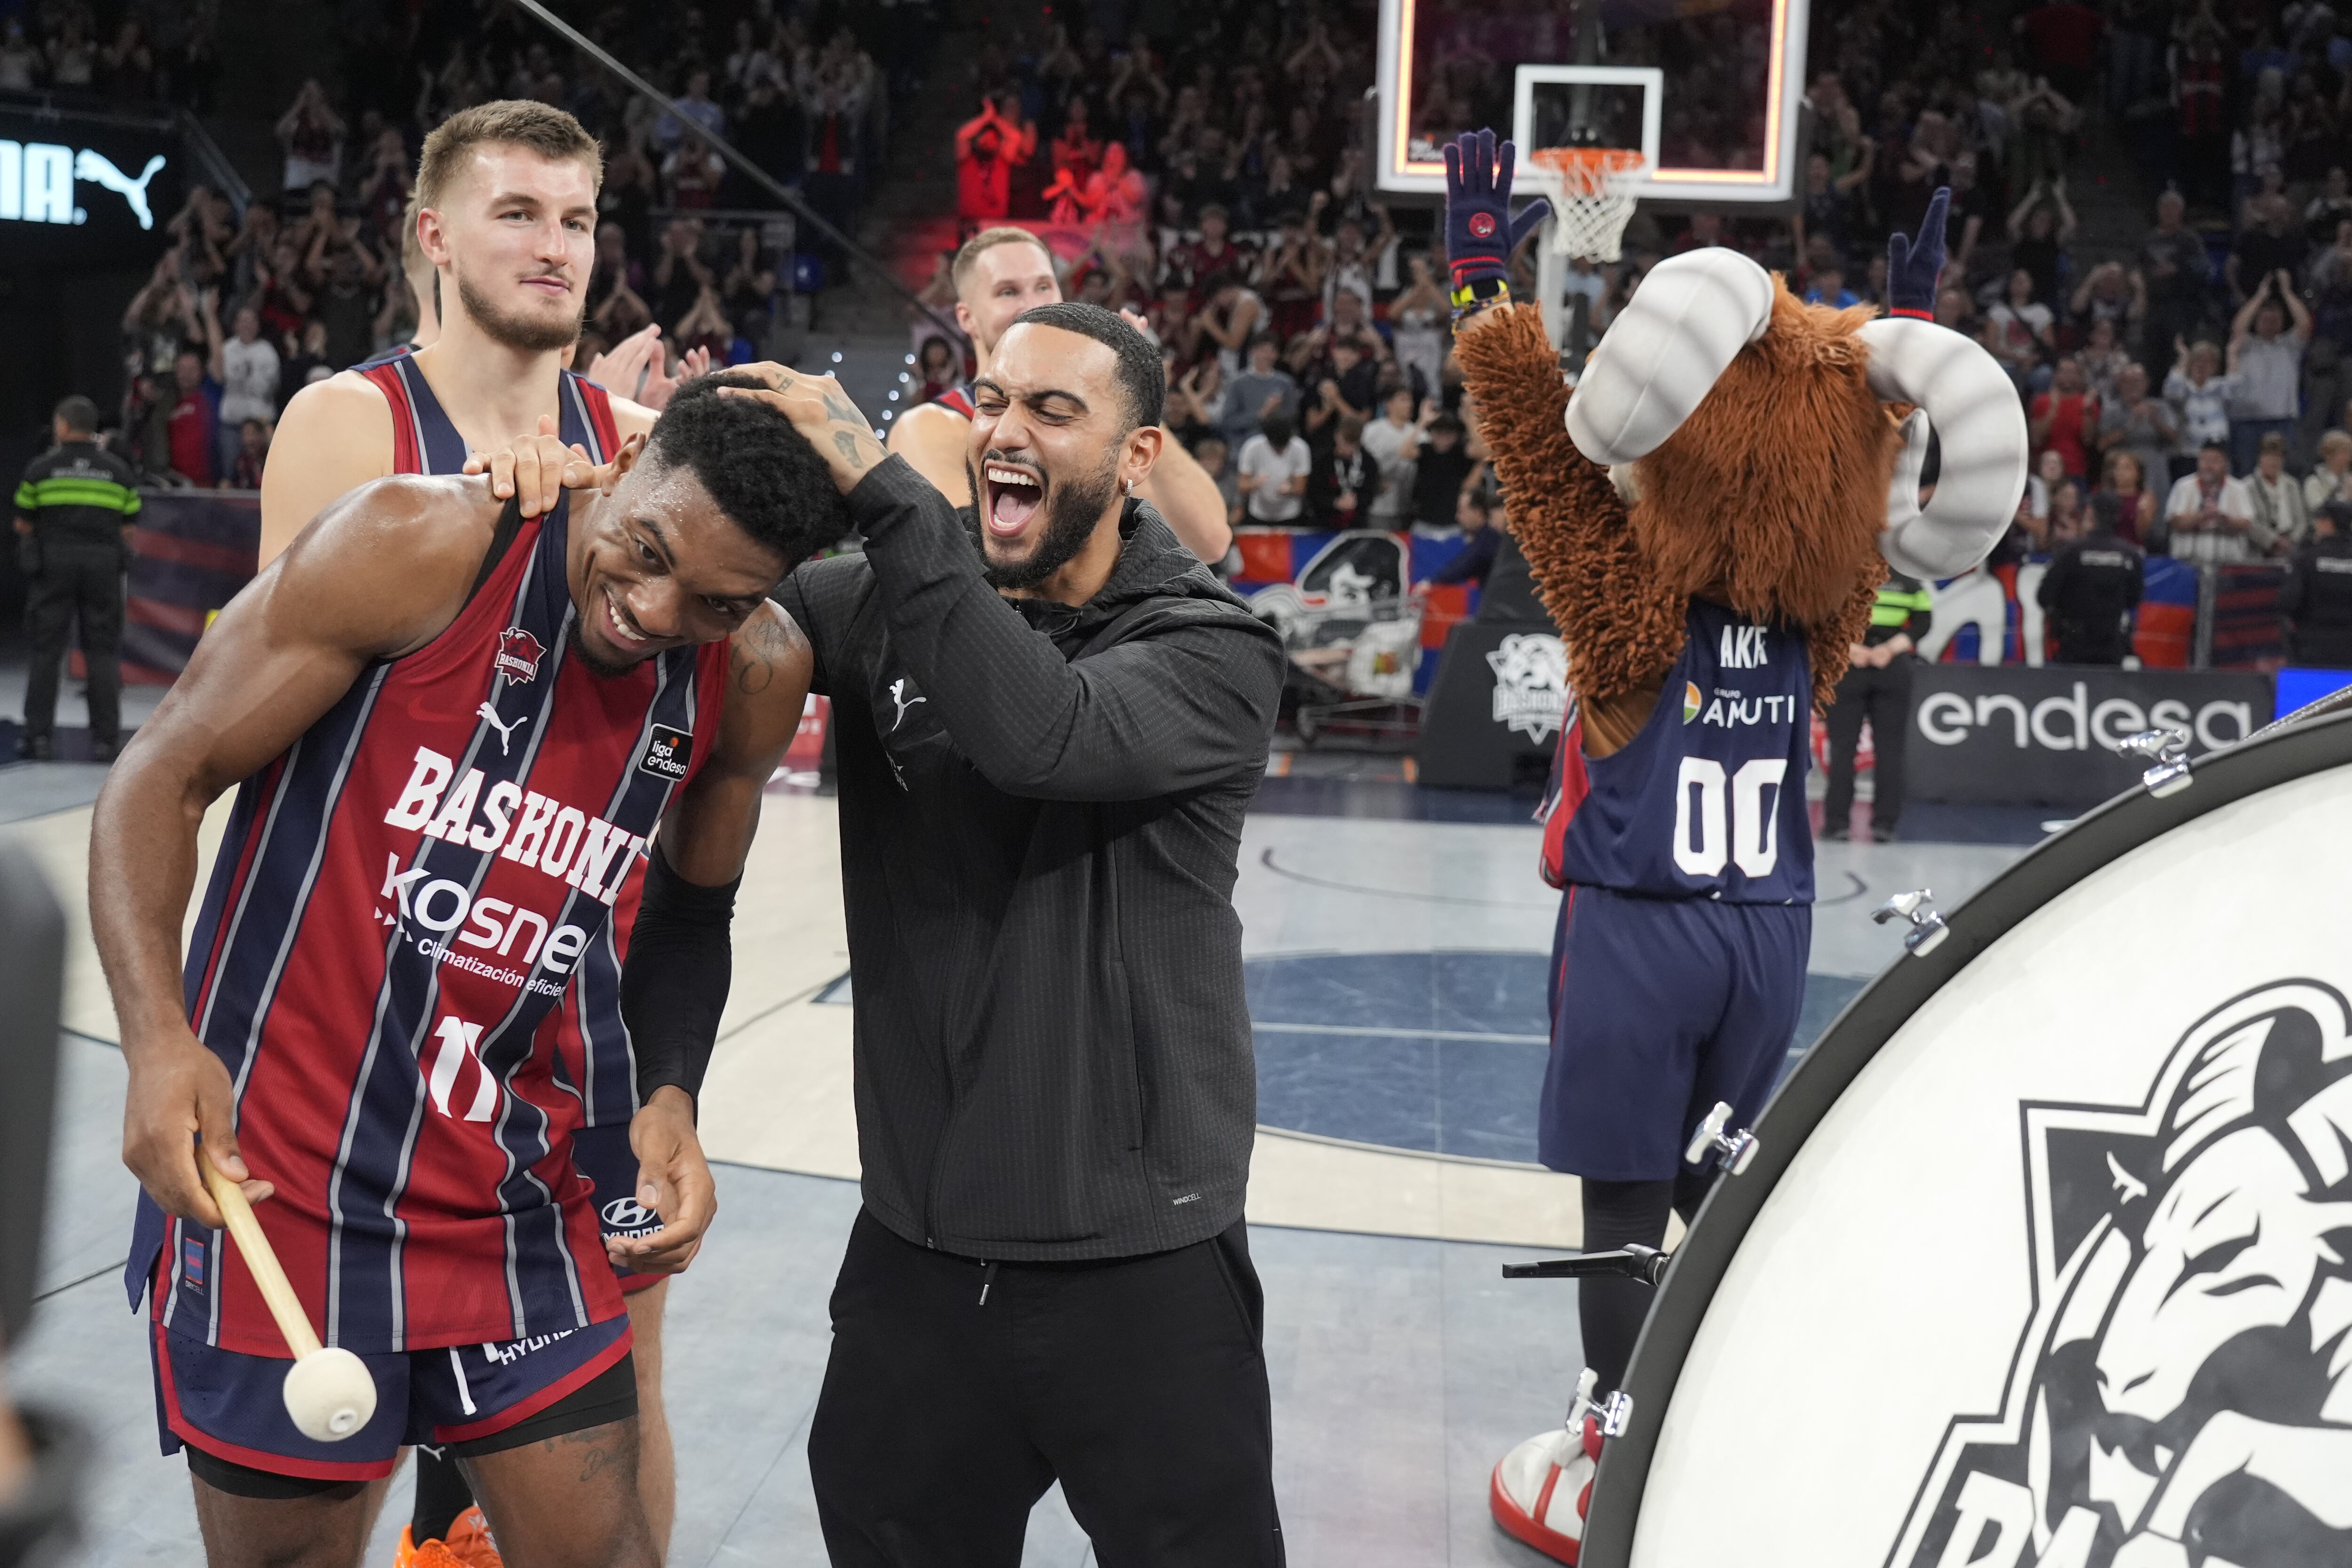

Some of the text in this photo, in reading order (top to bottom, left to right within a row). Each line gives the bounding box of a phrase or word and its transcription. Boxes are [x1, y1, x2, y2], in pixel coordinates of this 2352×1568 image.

[499, 653, 535, 676] BASKONIA
[1917, 681, 2251, 753] endesa
[652, 740, 673, 757] liga
[648, 756, 686, 774] endesa
[1673, 756, 1788, 878] 00
[418, 938, 524, 987] Climatización
[1173, 1193, 1201, 1206] WINDCELL
